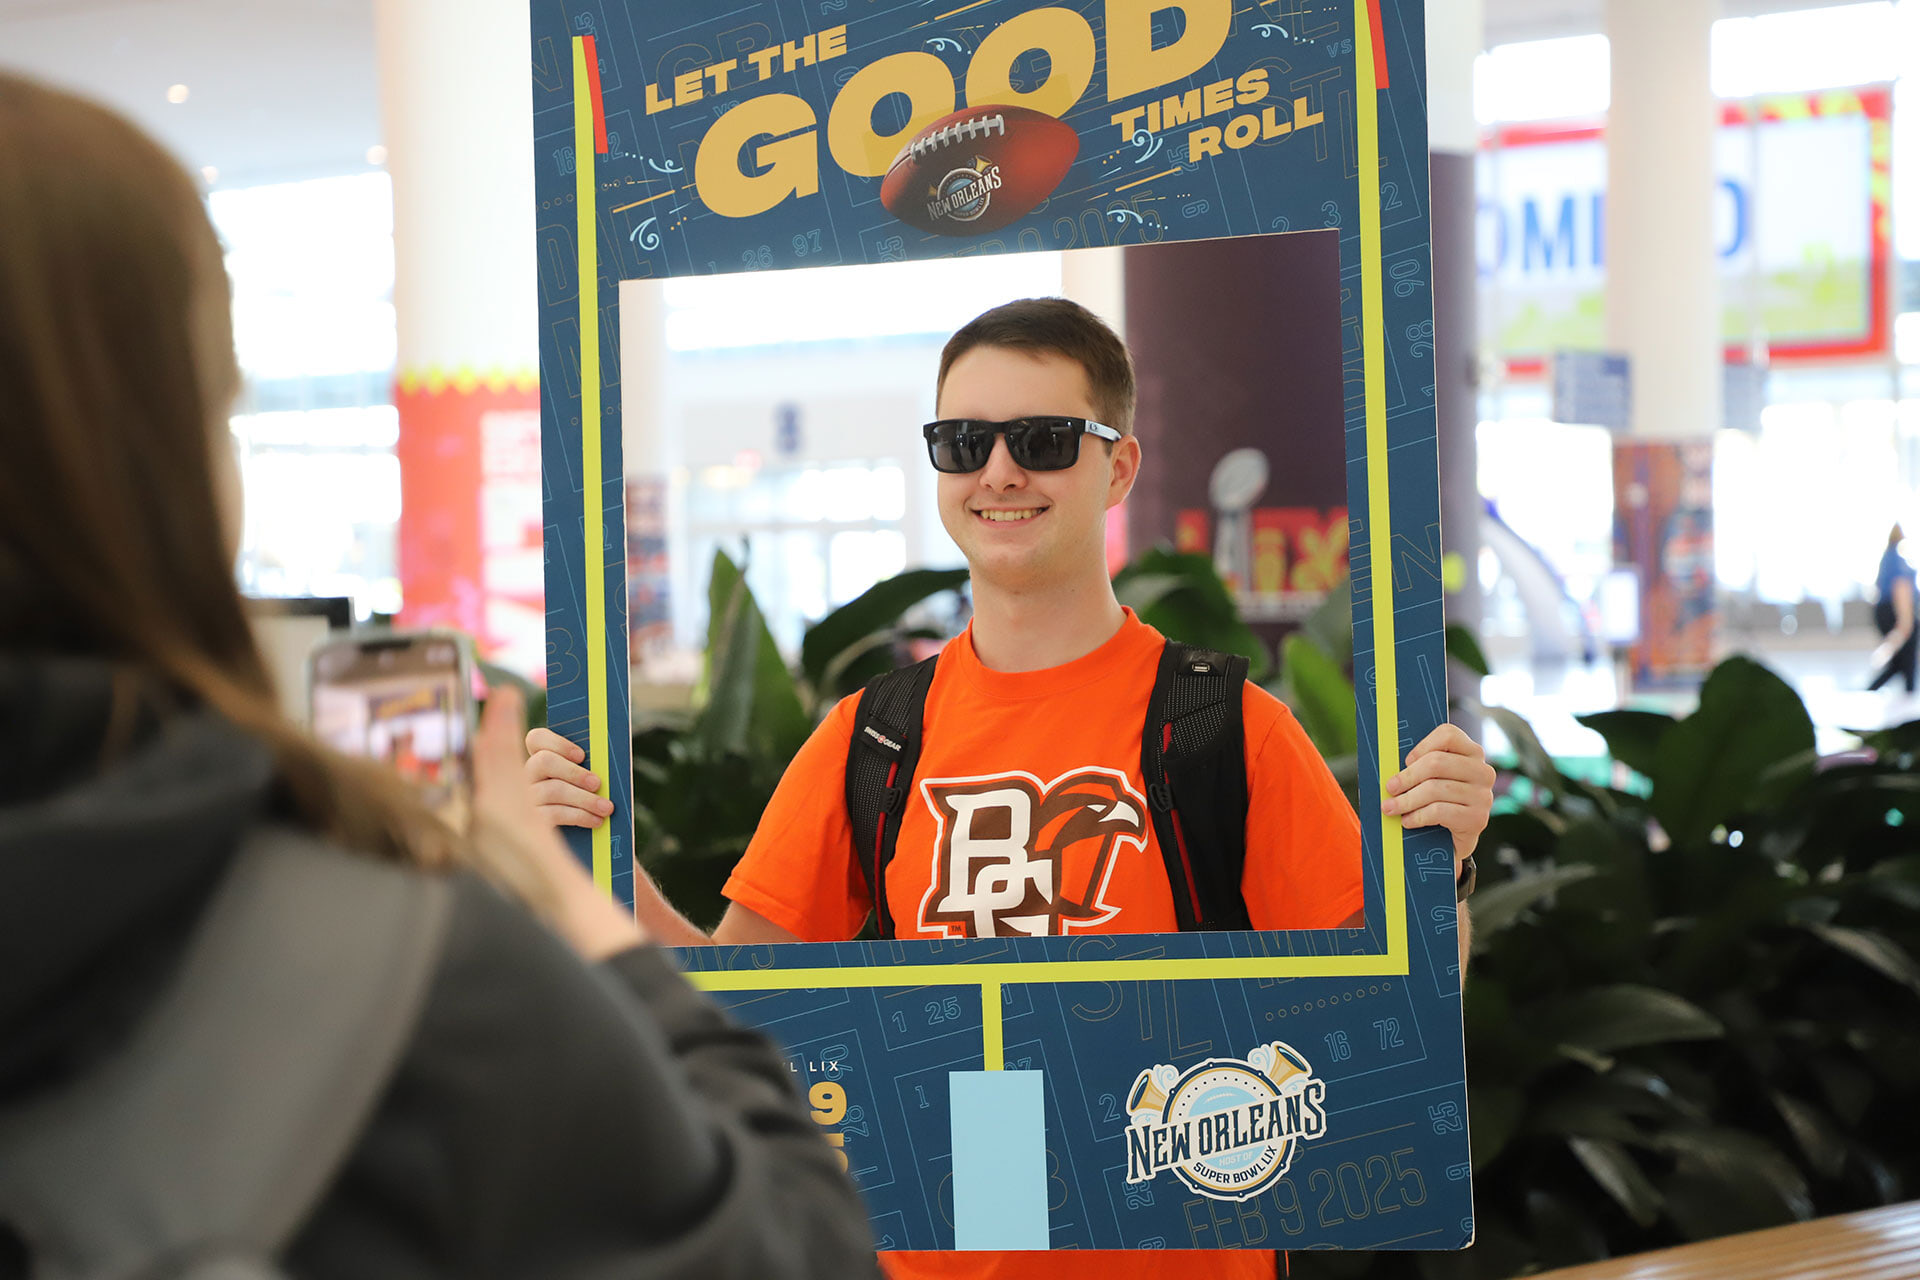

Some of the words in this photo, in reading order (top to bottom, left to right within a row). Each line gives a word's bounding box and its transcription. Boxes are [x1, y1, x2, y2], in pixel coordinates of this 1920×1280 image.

[645, 58, 737, 115] LET
[748, 24, 847, 82] THE
[695, 0, 1231, 218] GOOD
[1110, 68, 1270, 143] TIMES
[1188, 96, 1324, 163] ROLL
[926, 195, 951, 222] NEW
[951, 165, 1002, 210] ORLEANS
[792, 229, 822, 257] 97
[924, 996, 962, 1026] 25
[1323, 1029, 1353, 1063] 16
[1373, 1017, 1405, 1051] 72
[809, 1060, 840, 1072] LIX
[808, 1081, 848, 1126] 9
[1127, 1120, 1191, 1181] NEW
[1197, 1084, 1325, 1156] ORLEANS
[1193, 1162, 1231, 1185] SUPER
[1233, 1163, 1266, 1185] BOWL
[1263, 1144, 1278, 1167] LIX
[1218, 1153, 1239, 1167] HOST
[1240, 1150, 1253, 1164] OF
[1184, 1186, 1269, 1250] FEB
[1272, 1185, 1304, 1235] 9
[1309, 1148, 1428, 1229] 2025
